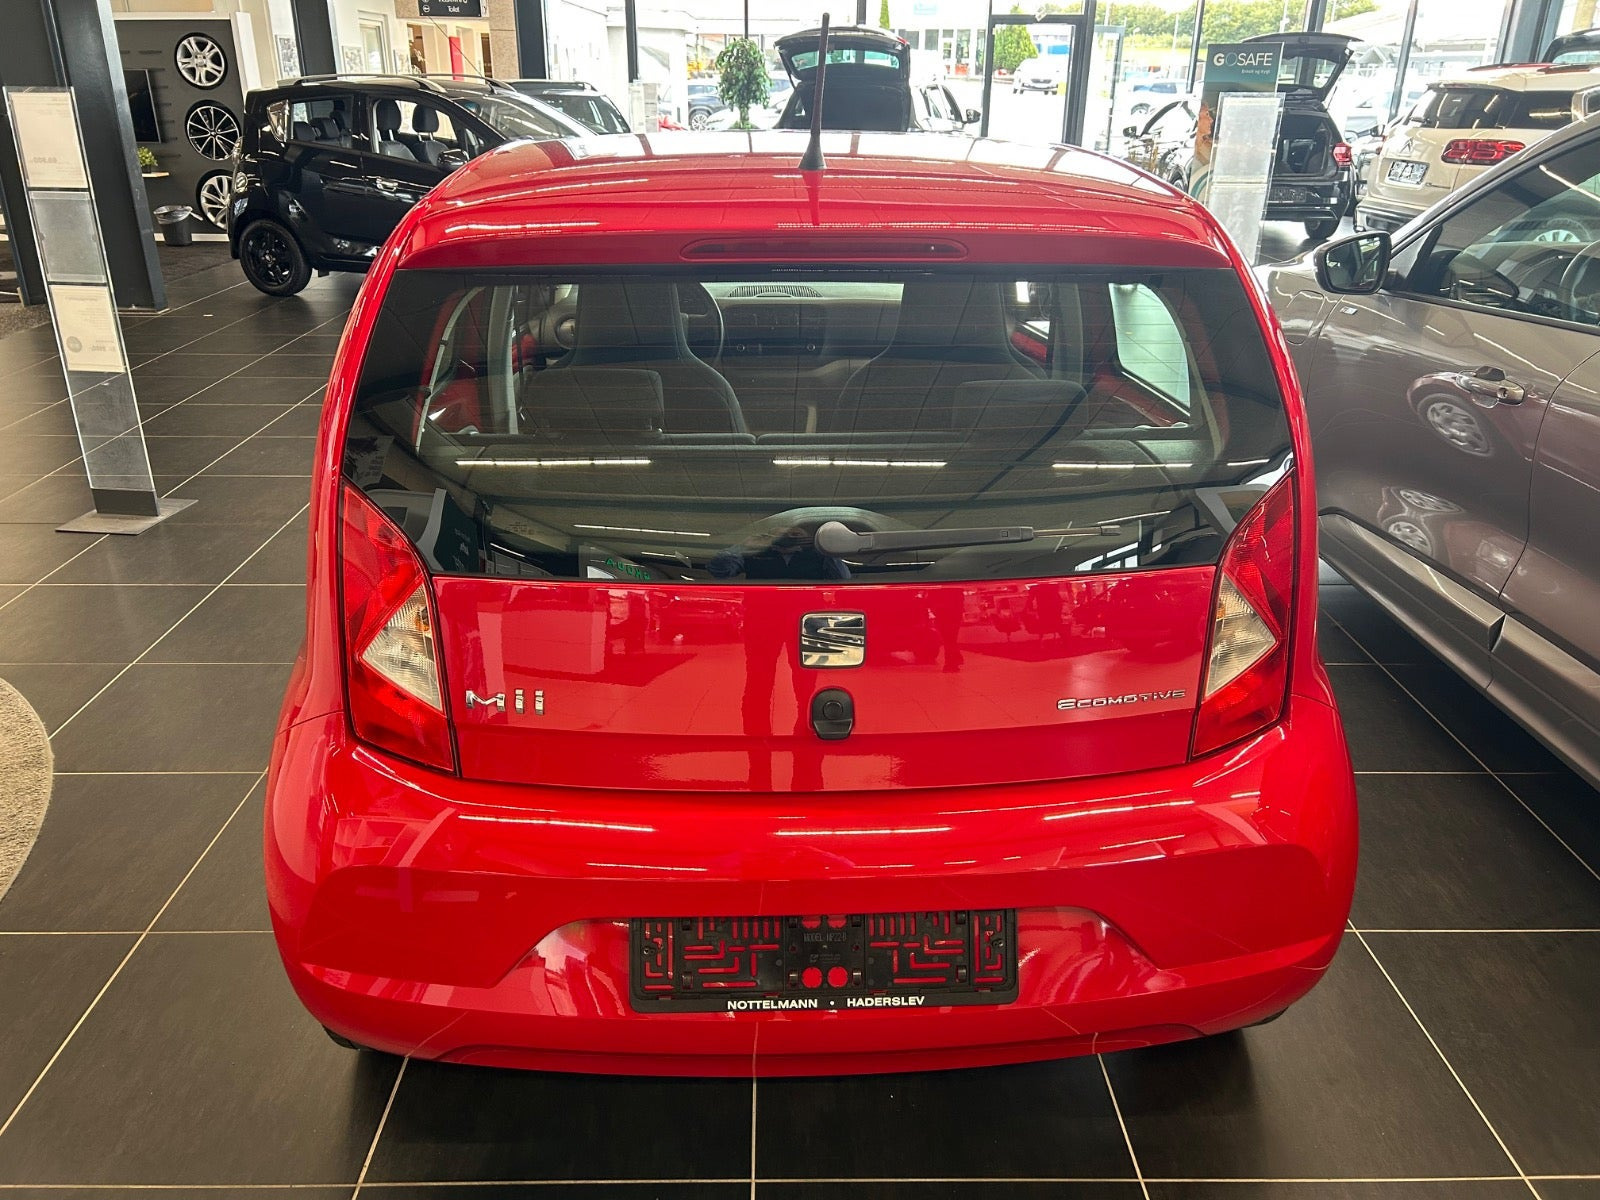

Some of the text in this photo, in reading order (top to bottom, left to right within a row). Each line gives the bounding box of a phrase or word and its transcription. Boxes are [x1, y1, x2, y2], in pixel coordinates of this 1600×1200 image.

[1213, 52, 1273, 67] GOSAFE
[465, 688, 545, 716] Mii
[1057, 689, 1186, 711] ECOMOTIVE
[727, 996, 926, 1011] NOTTELMANN HADERSLEV
